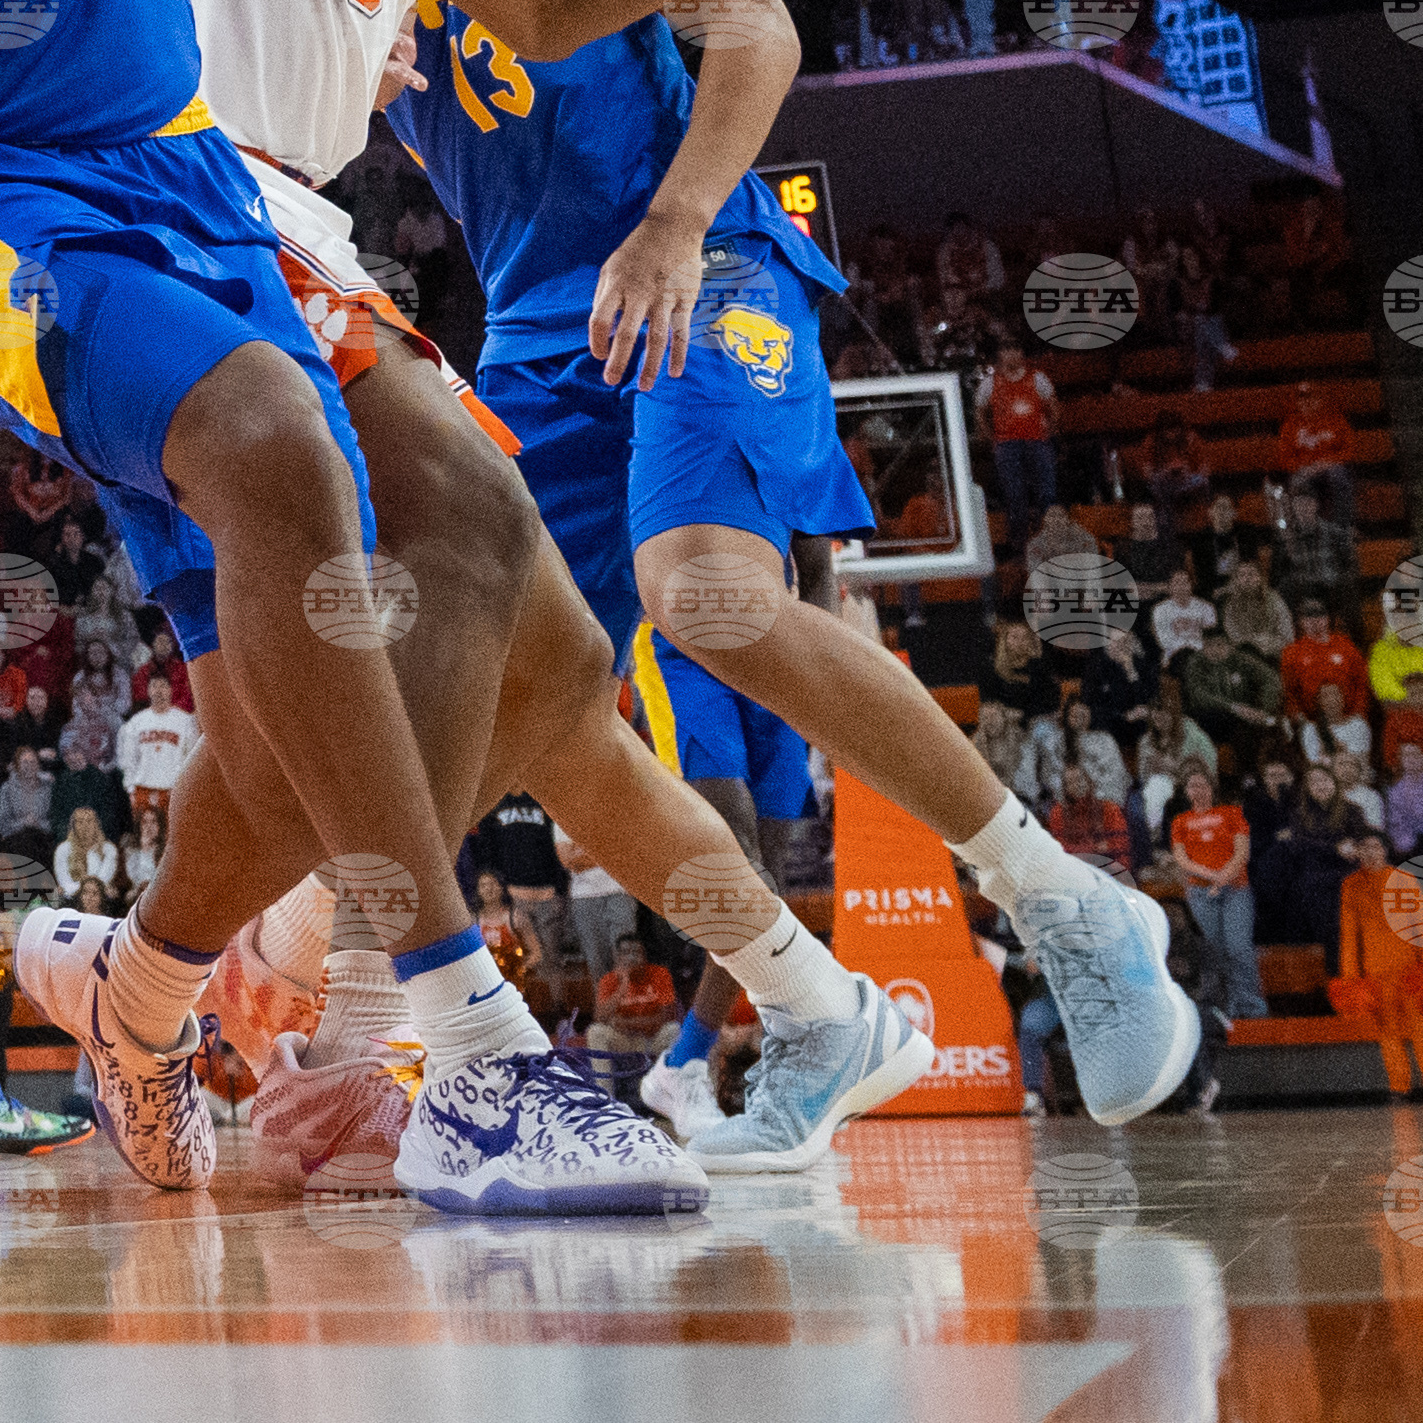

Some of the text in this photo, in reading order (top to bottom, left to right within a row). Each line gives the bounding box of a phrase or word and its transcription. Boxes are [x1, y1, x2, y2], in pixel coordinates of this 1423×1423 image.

[779, 174, 817, 213] 16
[709, 249, 727, 263] 50
[843, 886, 954, 911] PRISMA
